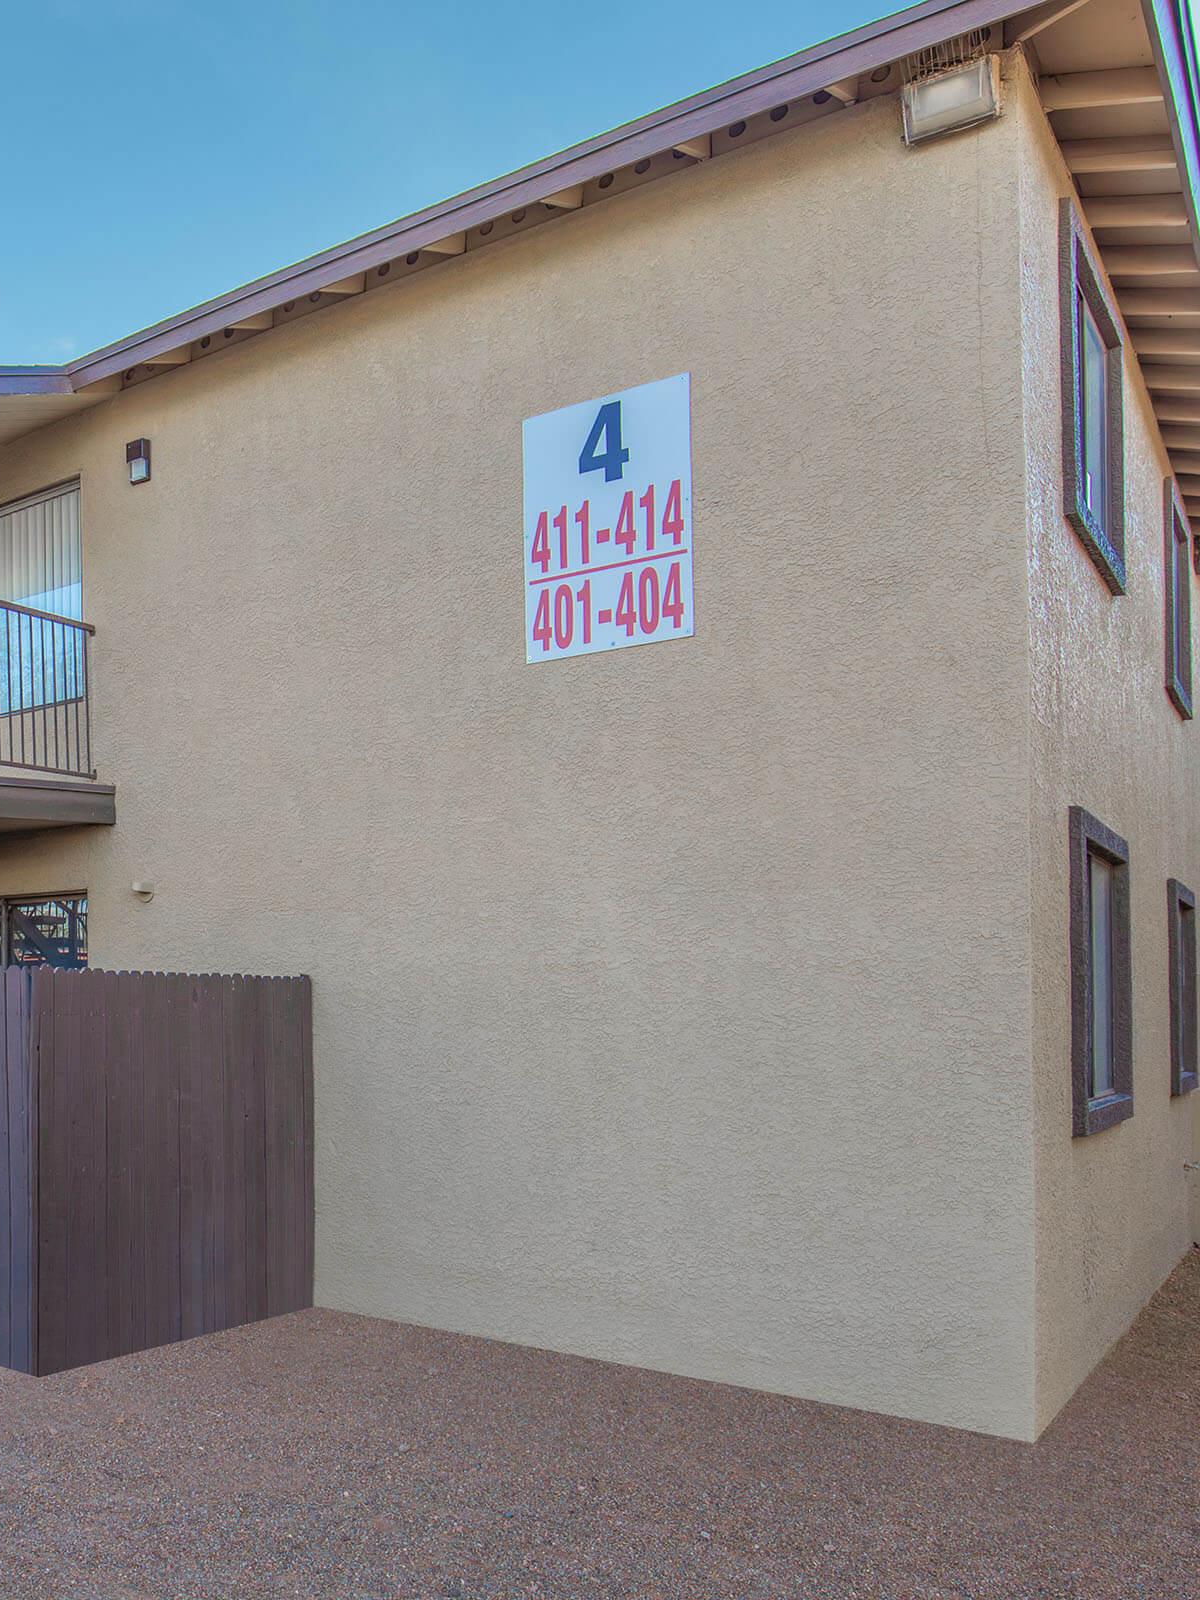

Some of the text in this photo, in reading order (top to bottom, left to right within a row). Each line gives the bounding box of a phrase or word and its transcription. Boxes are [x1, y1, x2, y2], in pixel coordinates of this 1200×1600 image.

[579, 400, 629, 482] 4
[531, 479, 684, 573] 411-414
[533, 562, 684, 651] 401-404
